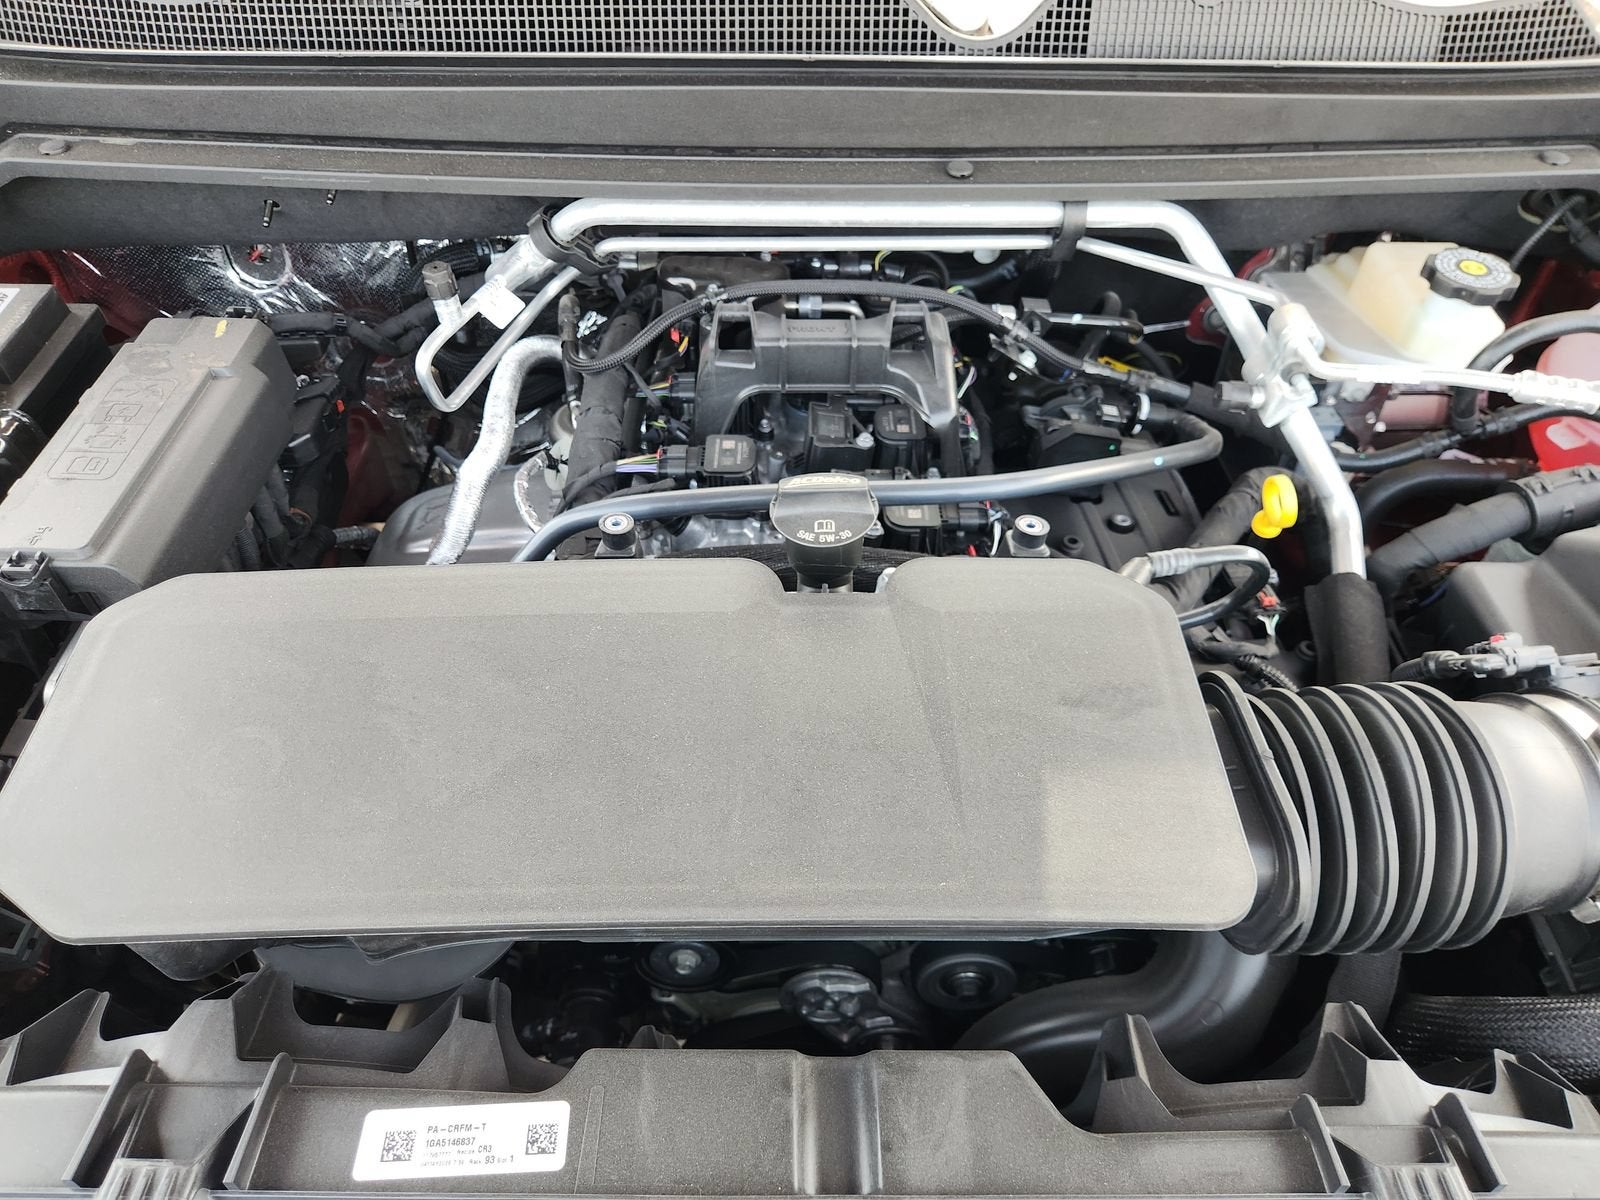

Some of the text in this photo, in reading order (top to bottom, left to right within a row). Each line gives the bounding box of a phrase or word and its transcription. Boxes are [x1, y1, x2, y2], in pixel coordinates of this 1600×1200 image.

[797, 530, 852, 543] SAE 5W-30
[478, 1145, 492, 1153] CR3
[485, 1156, 495, 1164] 93
